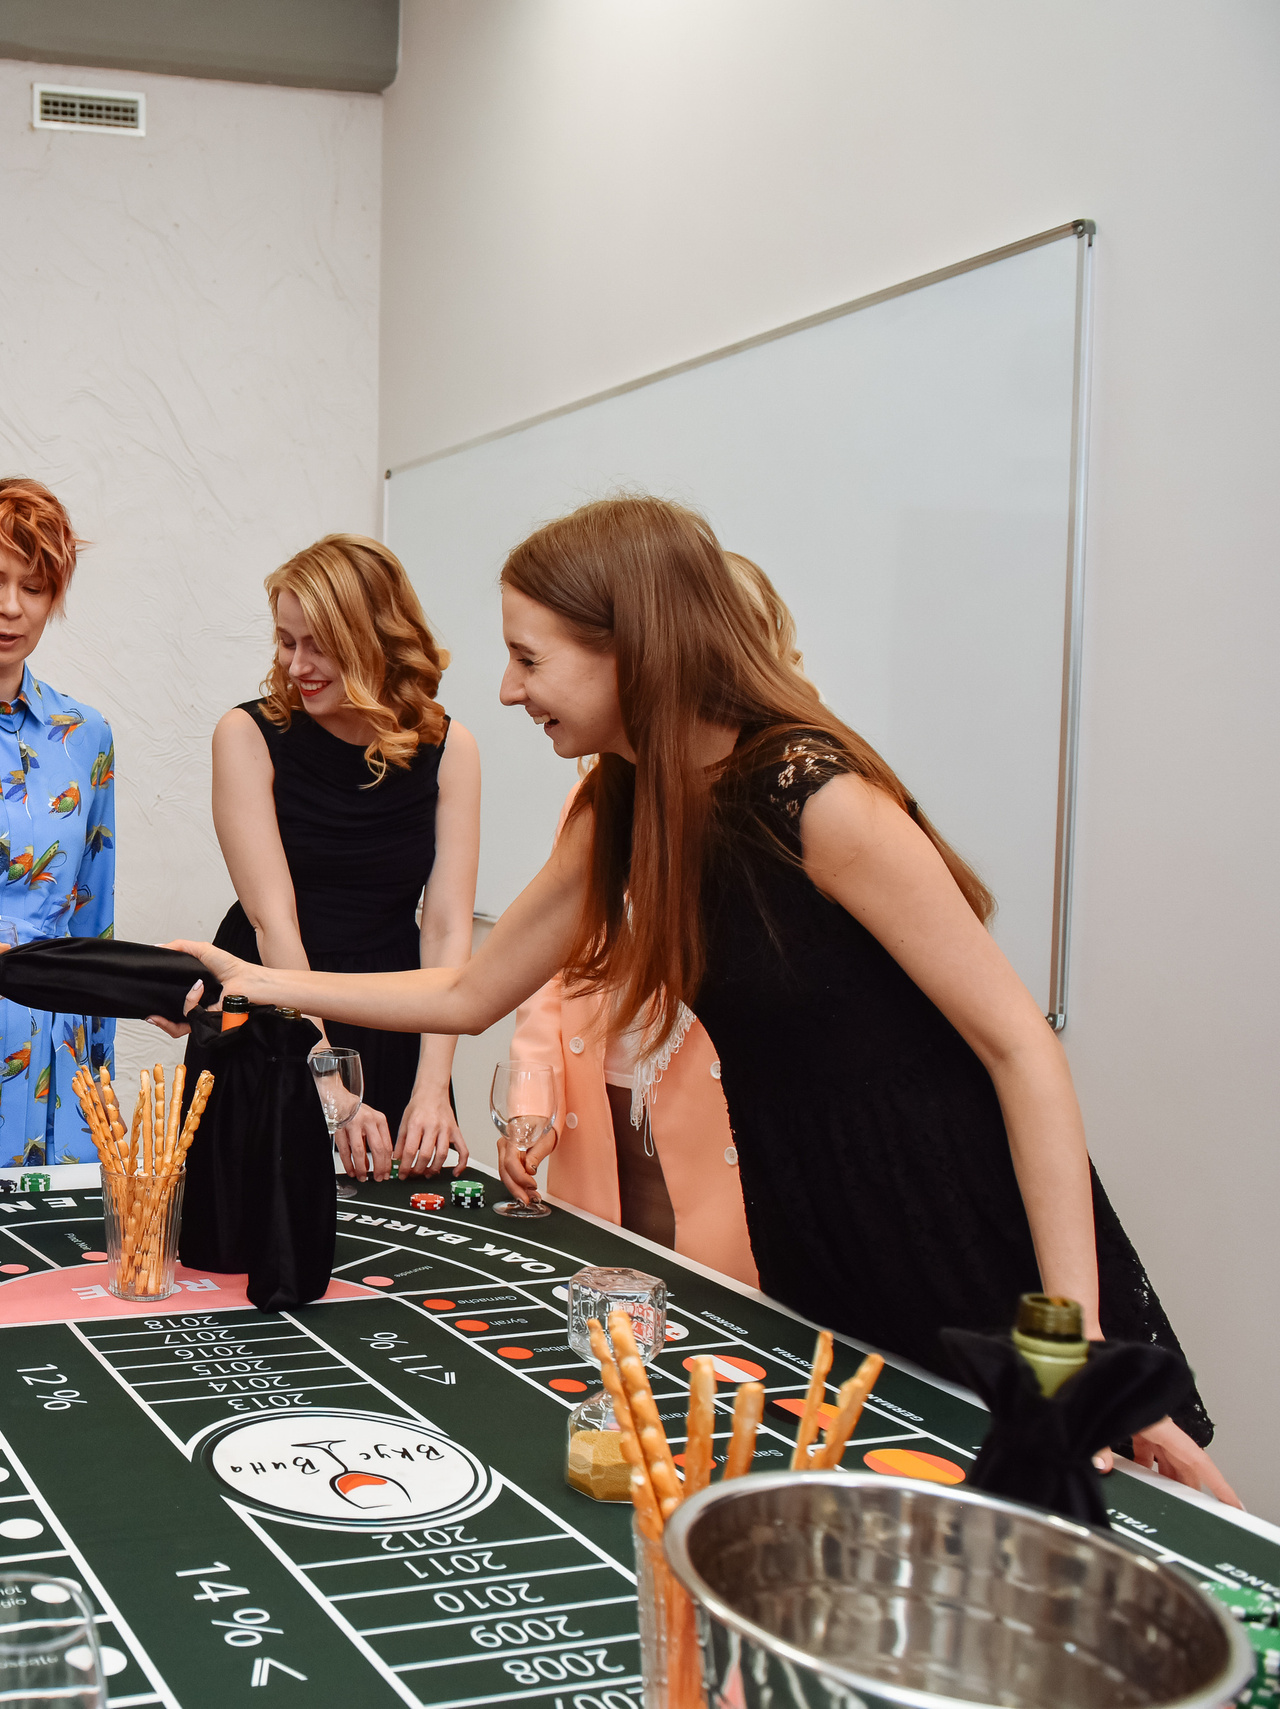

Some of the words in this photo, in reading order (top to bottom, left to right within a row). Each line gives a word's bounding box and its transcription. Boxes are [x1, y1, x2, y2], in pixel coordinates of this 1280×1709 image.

[337, 1211, 473, 1245] BARRE
[468, 1243, 556, 1274] OAK
[144, 1315, 219, 1330] 2018
[489, 1317, 528, 1326] Syrah
[700, 1310, 749, 1335] GEORGIA
[164, 1329, 236, 1345] 2017
[532, 1343, 572, 1354] albec
[174, 1344, 253, 1360] 2016
[772, 1347, 815, 1371] USTRIA
[191, 1359, 272, 1375] 2015
[16, 1363, 88, 1411] 12%
[208, 1375, 291, 1392] 2014
[227, 1392, 313, 1411] 2013
[867, 1393, 925, 1422] GERMAN
[359, 1443, 445, 1462] Вкус
[371, 1525, 478, 1552] 2012
[403, 1550, 508, 1579] 2011
[432, 1581, 546, 1614] 2010
[470, 1614, 585, 1648] 2009
[502, 1648, 626, 1685] 2008
